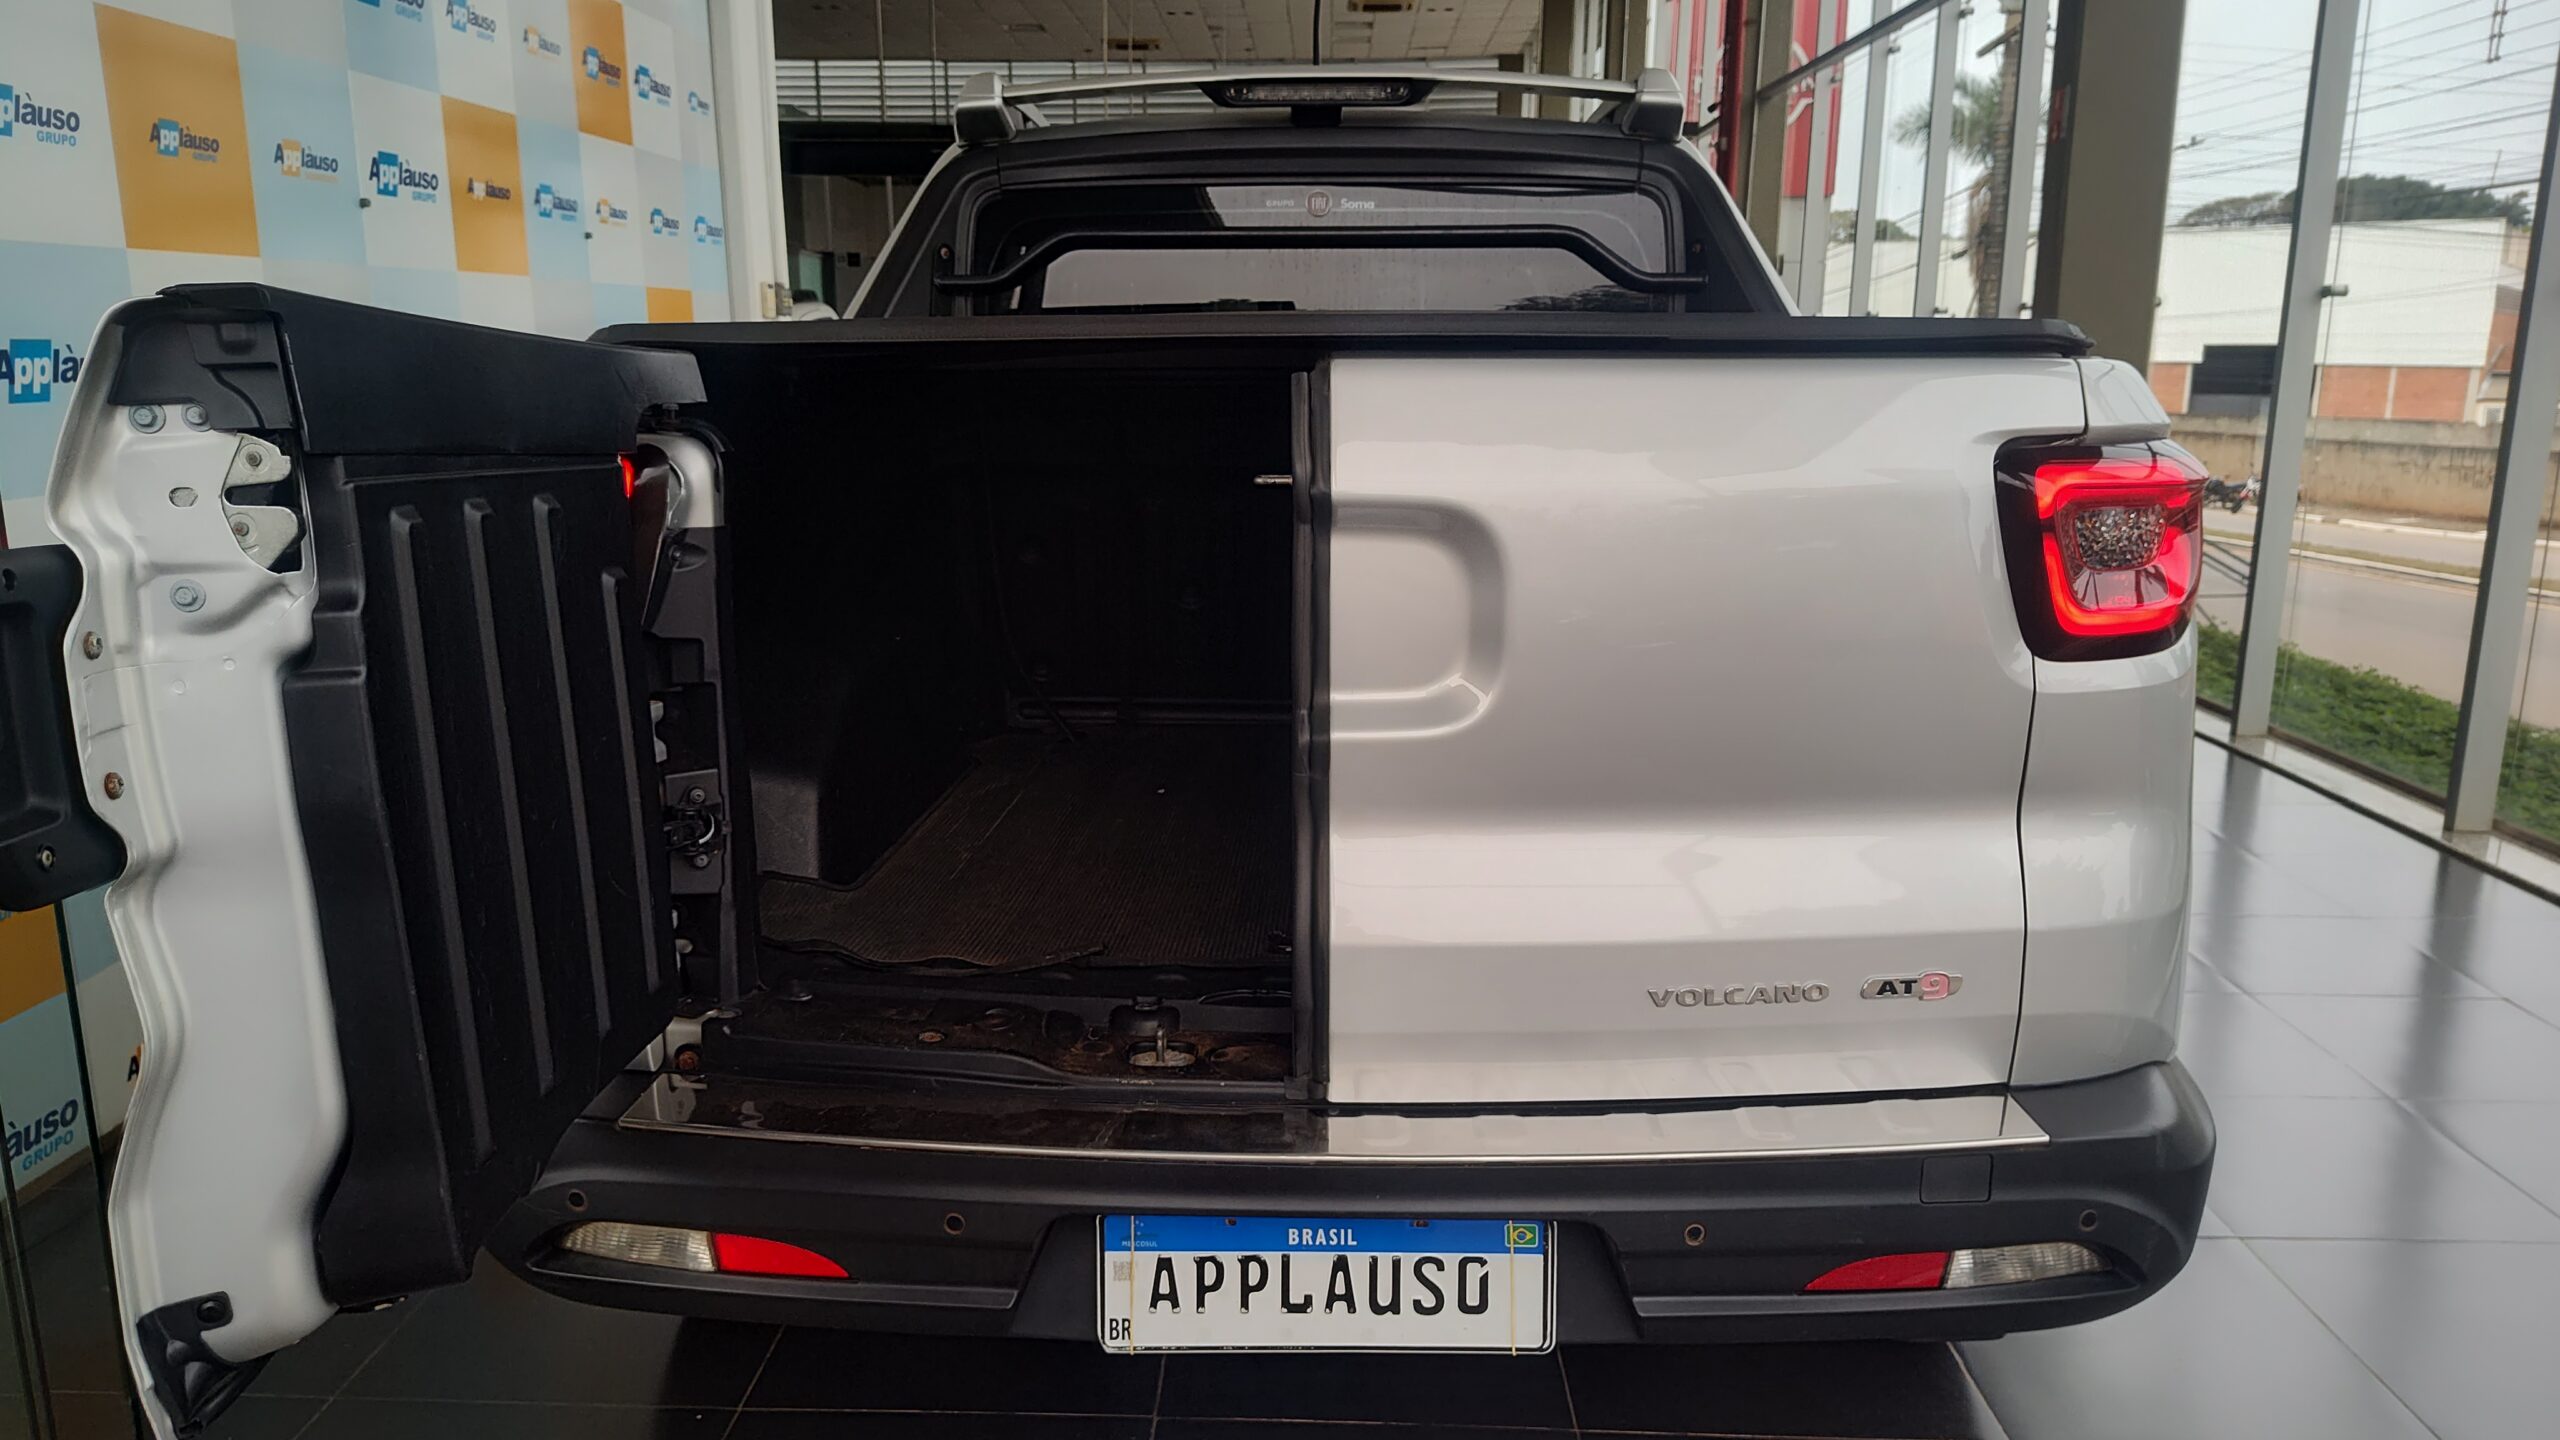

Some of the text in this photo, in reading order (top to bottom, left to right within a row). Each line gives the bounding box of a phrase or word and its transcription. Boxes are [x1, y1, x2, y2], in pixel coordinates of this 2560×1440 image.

[0, 92, 80, 132] plàuso
[37, 130, 77, 147] GRUPO
[369, 157, 438, 191] Applàuso
[1340, 198, 1375, 209] Soma
[0, 344, 86, 394] Applà
[1647, 970, 1951, 1008] VOLCANO AT9
[7, 1098, 79, 1160] àuso
[22, 1129, 74, 1171] GRUPO
[1121, 1240, 1159, 1248] MECOSUL
[1287, 1227, 1358, 1246] BRASIL
[1148, 1254, 1490, 1317] APPLAUSO
[1109, 1317, 1131, 1341] BR
